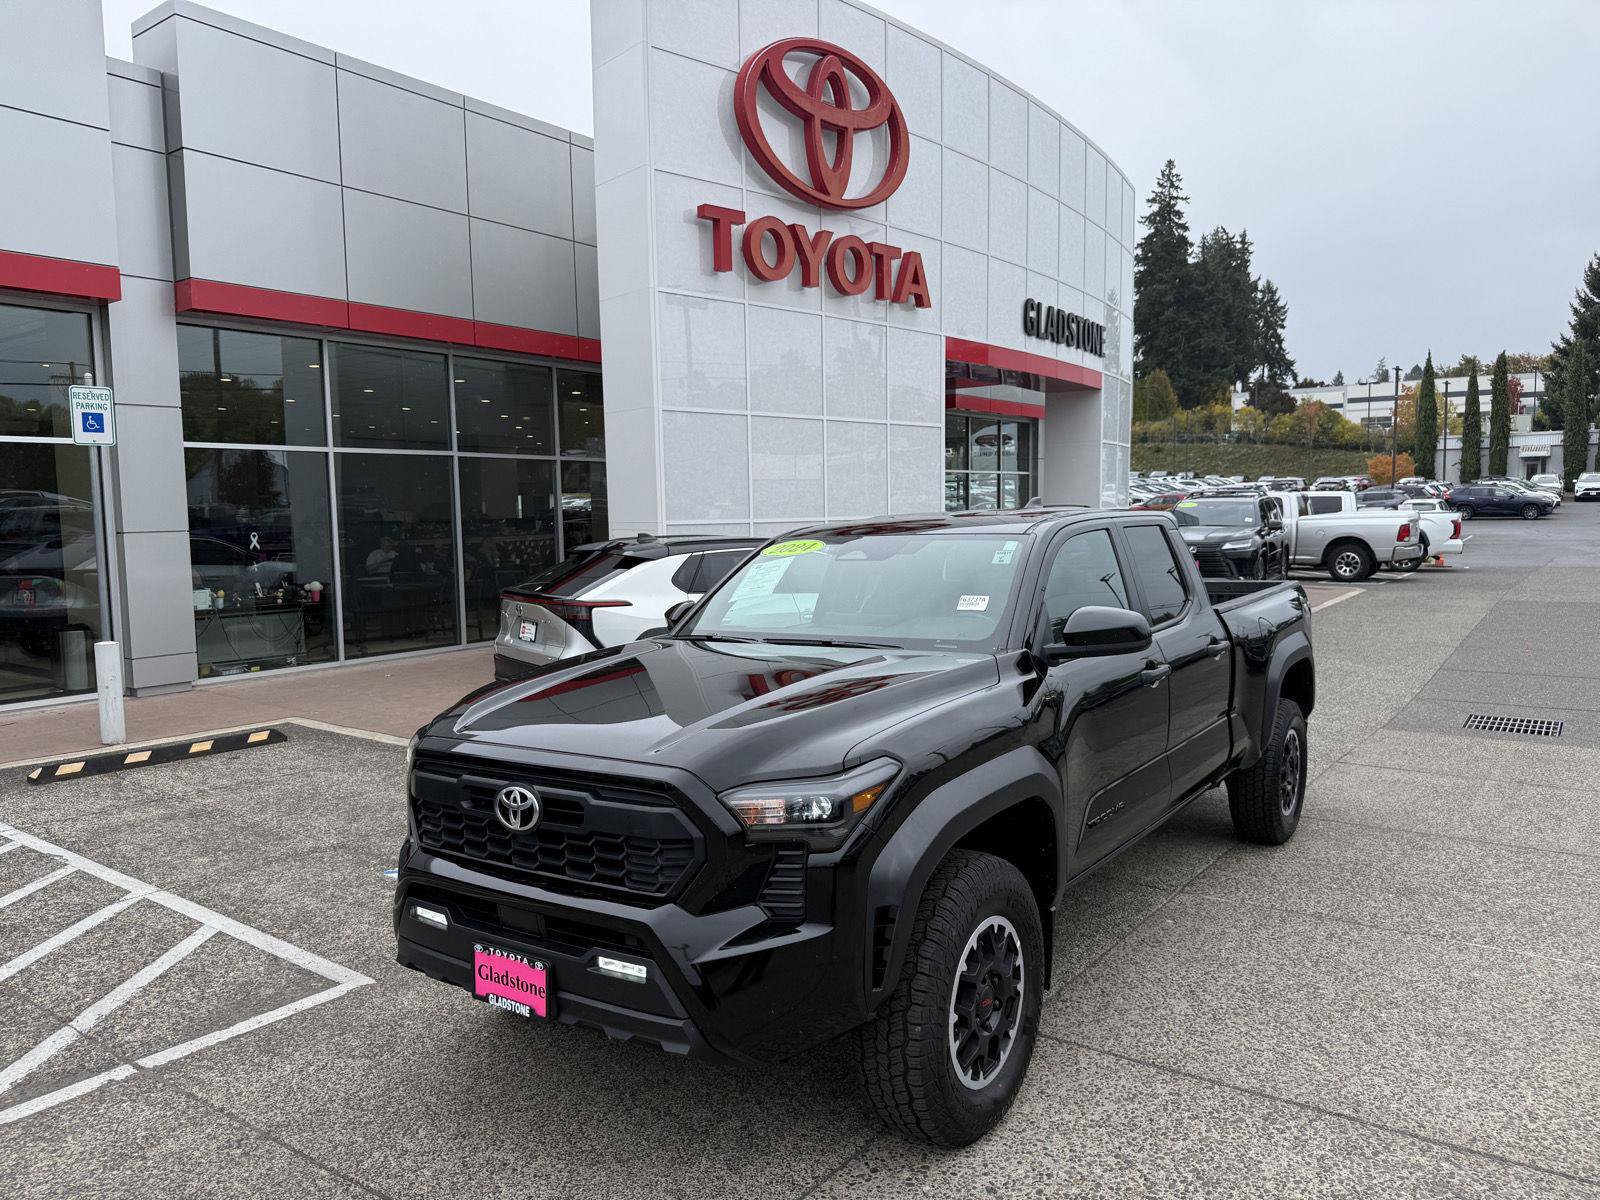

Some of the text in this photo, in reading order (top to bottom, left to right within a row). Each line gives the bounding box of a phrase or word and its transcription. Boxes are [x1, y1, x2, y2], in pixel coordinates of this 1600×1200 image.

[697, 203, 932, 309] TOYOTA
[1023, 298, 1106, 358] GLADSTONE
[72, 391, 110, 401] RESERVED
[75, 402, 108, 411] PARKING
[489, 947, 529, 965] TOYOTA
[478, 964, 546, 999] Gladstone
[488, 993, 531, 1018] GLADSTONE
